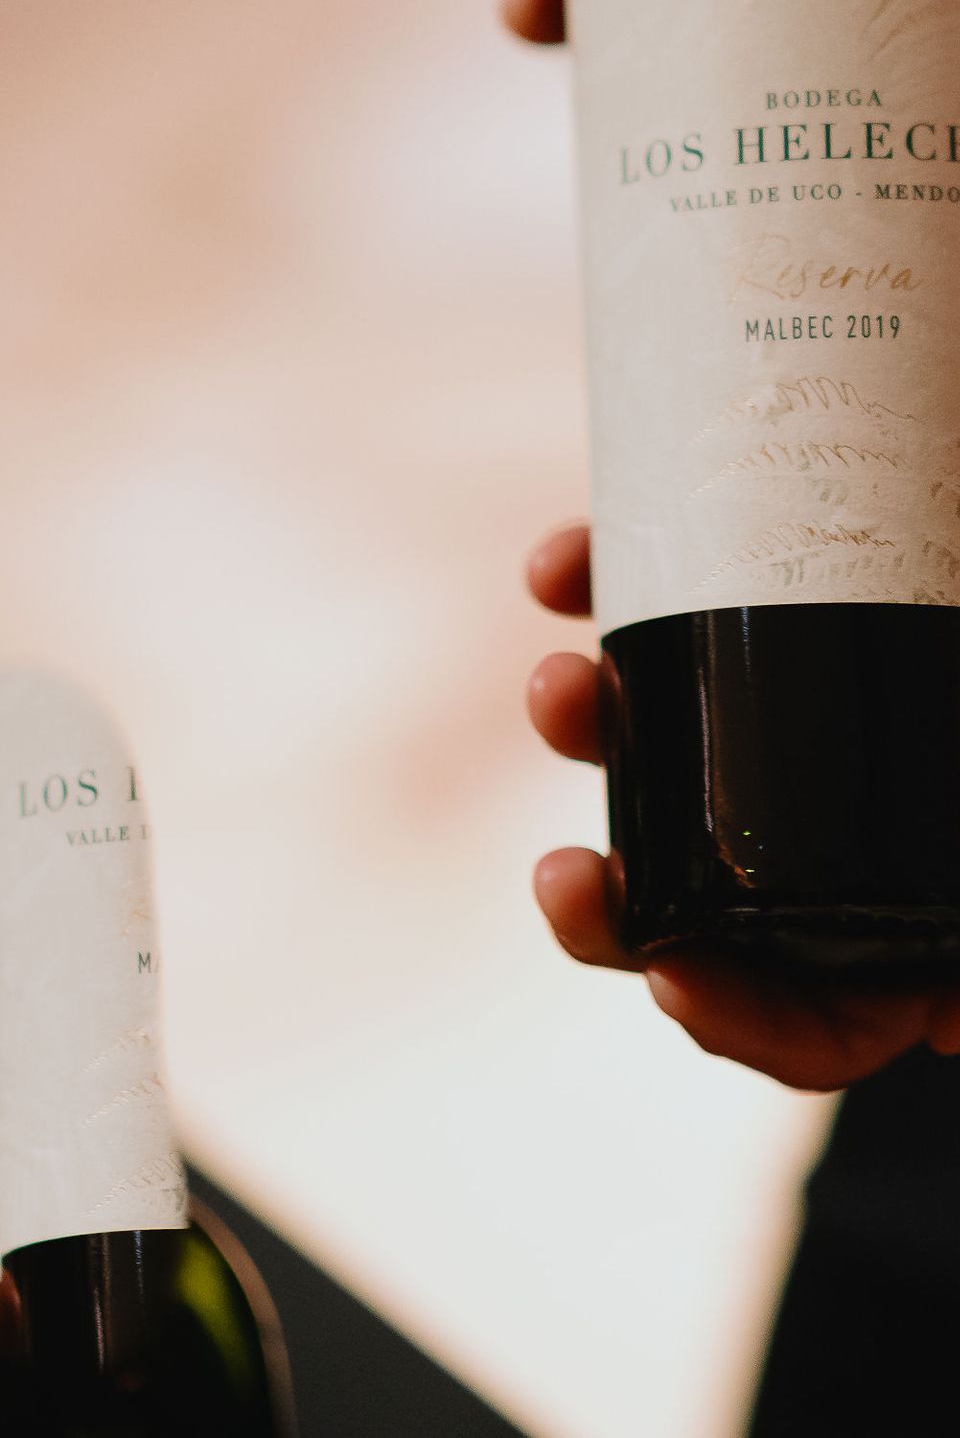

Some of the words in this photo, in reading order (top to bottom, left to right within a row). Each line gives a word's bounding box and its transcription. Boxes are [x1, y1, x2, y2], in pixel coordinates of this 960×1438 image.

[766, 89, 882, 110] BODEGA
[620, 133, 704, 186] LOS
[669, 190, 738, 212] VALLE
[749, 186, 780, 204] DE
[792, 184, 842, 201] UCO
[728, 233, 924, 306] Reserva
[744, 316, 833, 342] MALBEC
[847, 315, 901, 339] 2019
[18, 769, 98, 819] LOS
[66, 826, 130, 846] VALLE
